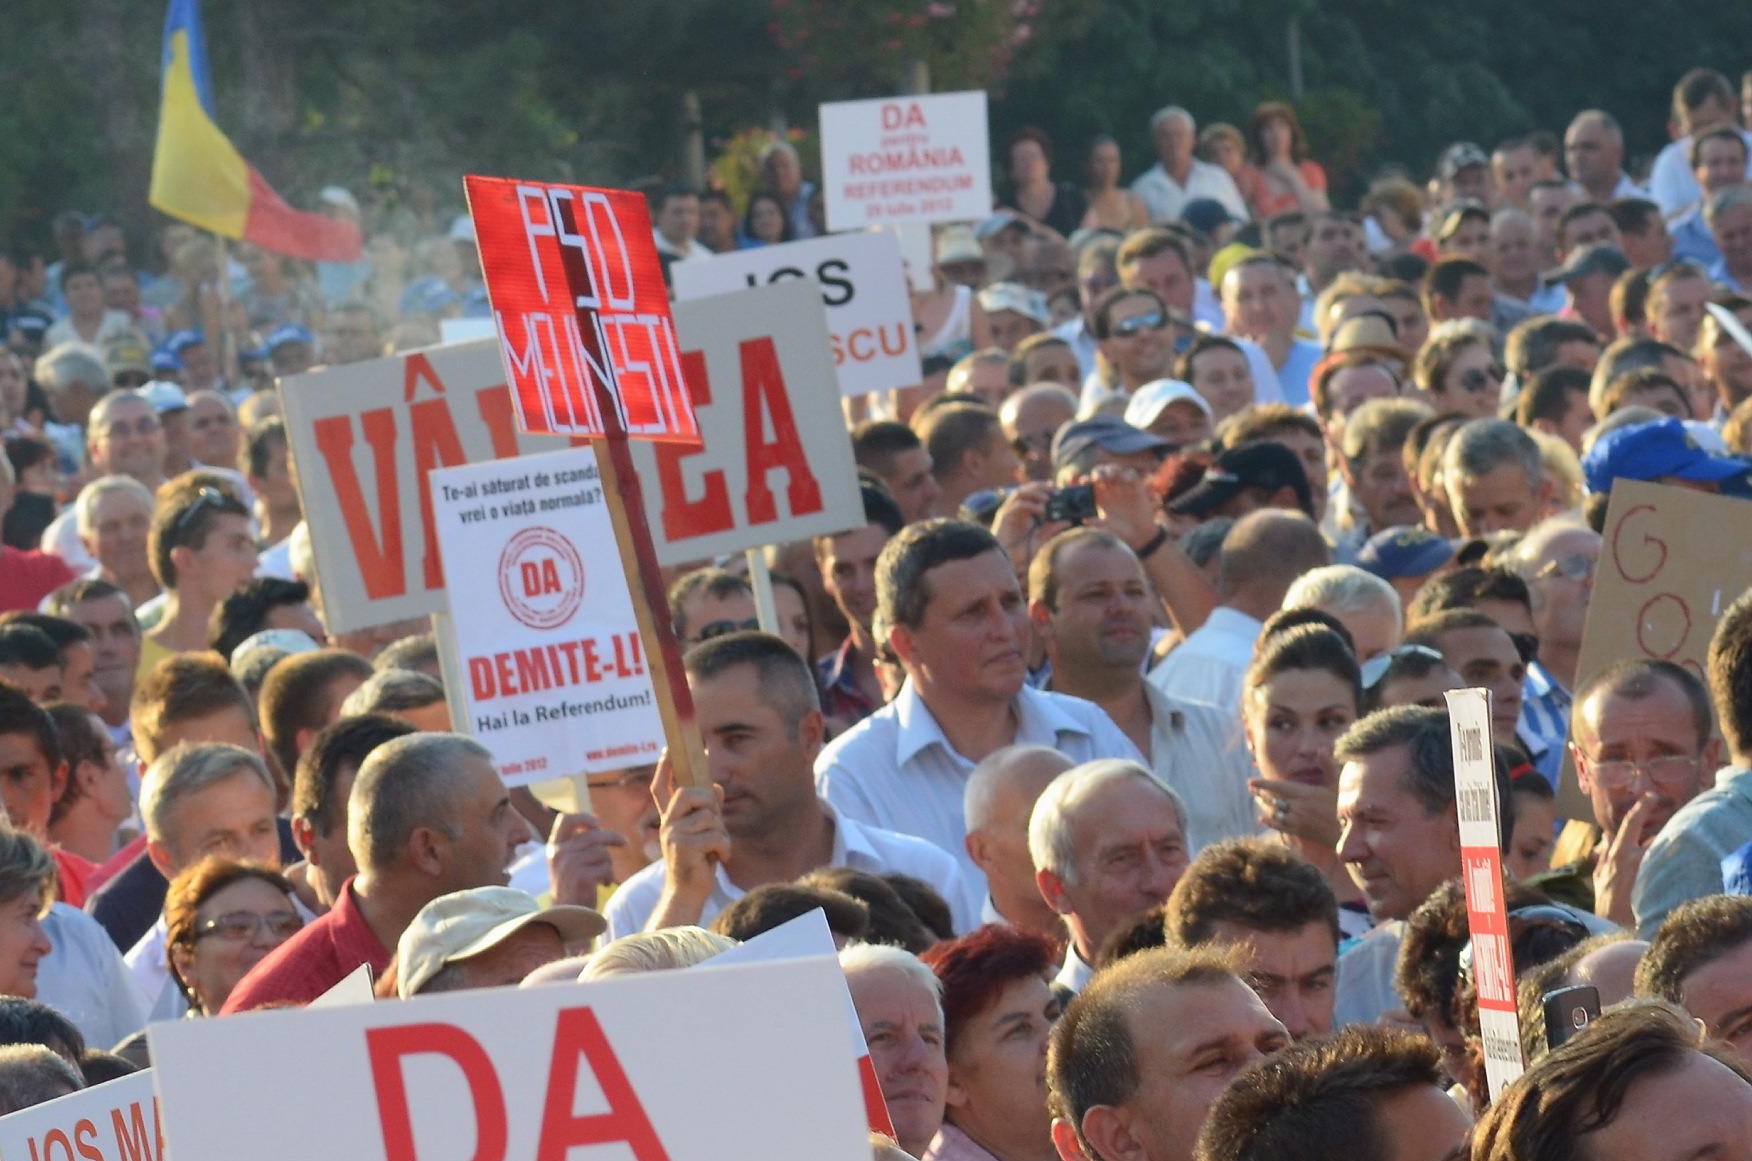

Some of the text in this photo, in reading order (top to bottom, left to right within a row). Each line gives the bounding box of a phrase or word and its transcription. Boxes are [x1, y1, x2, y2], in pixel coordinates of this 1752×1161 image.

[881, 103, 927, 131] DA
[850, 146, 964, 175] ROMÂNIA
[843, 174, 973, 199] REFERENDUM
[516, 184, 636, 310] PSD
[312, 336, 823, 600] VÂEA
[534, 472, 551, 488] de
[459, 503, 487, 524] vrei
[490, 507, 498, 519] o
[520, 558, 562, 598] DA
[468, 632, 644, 702] DEMITE-L!
[477, 690, 652, 733] Hai la Referendum!
